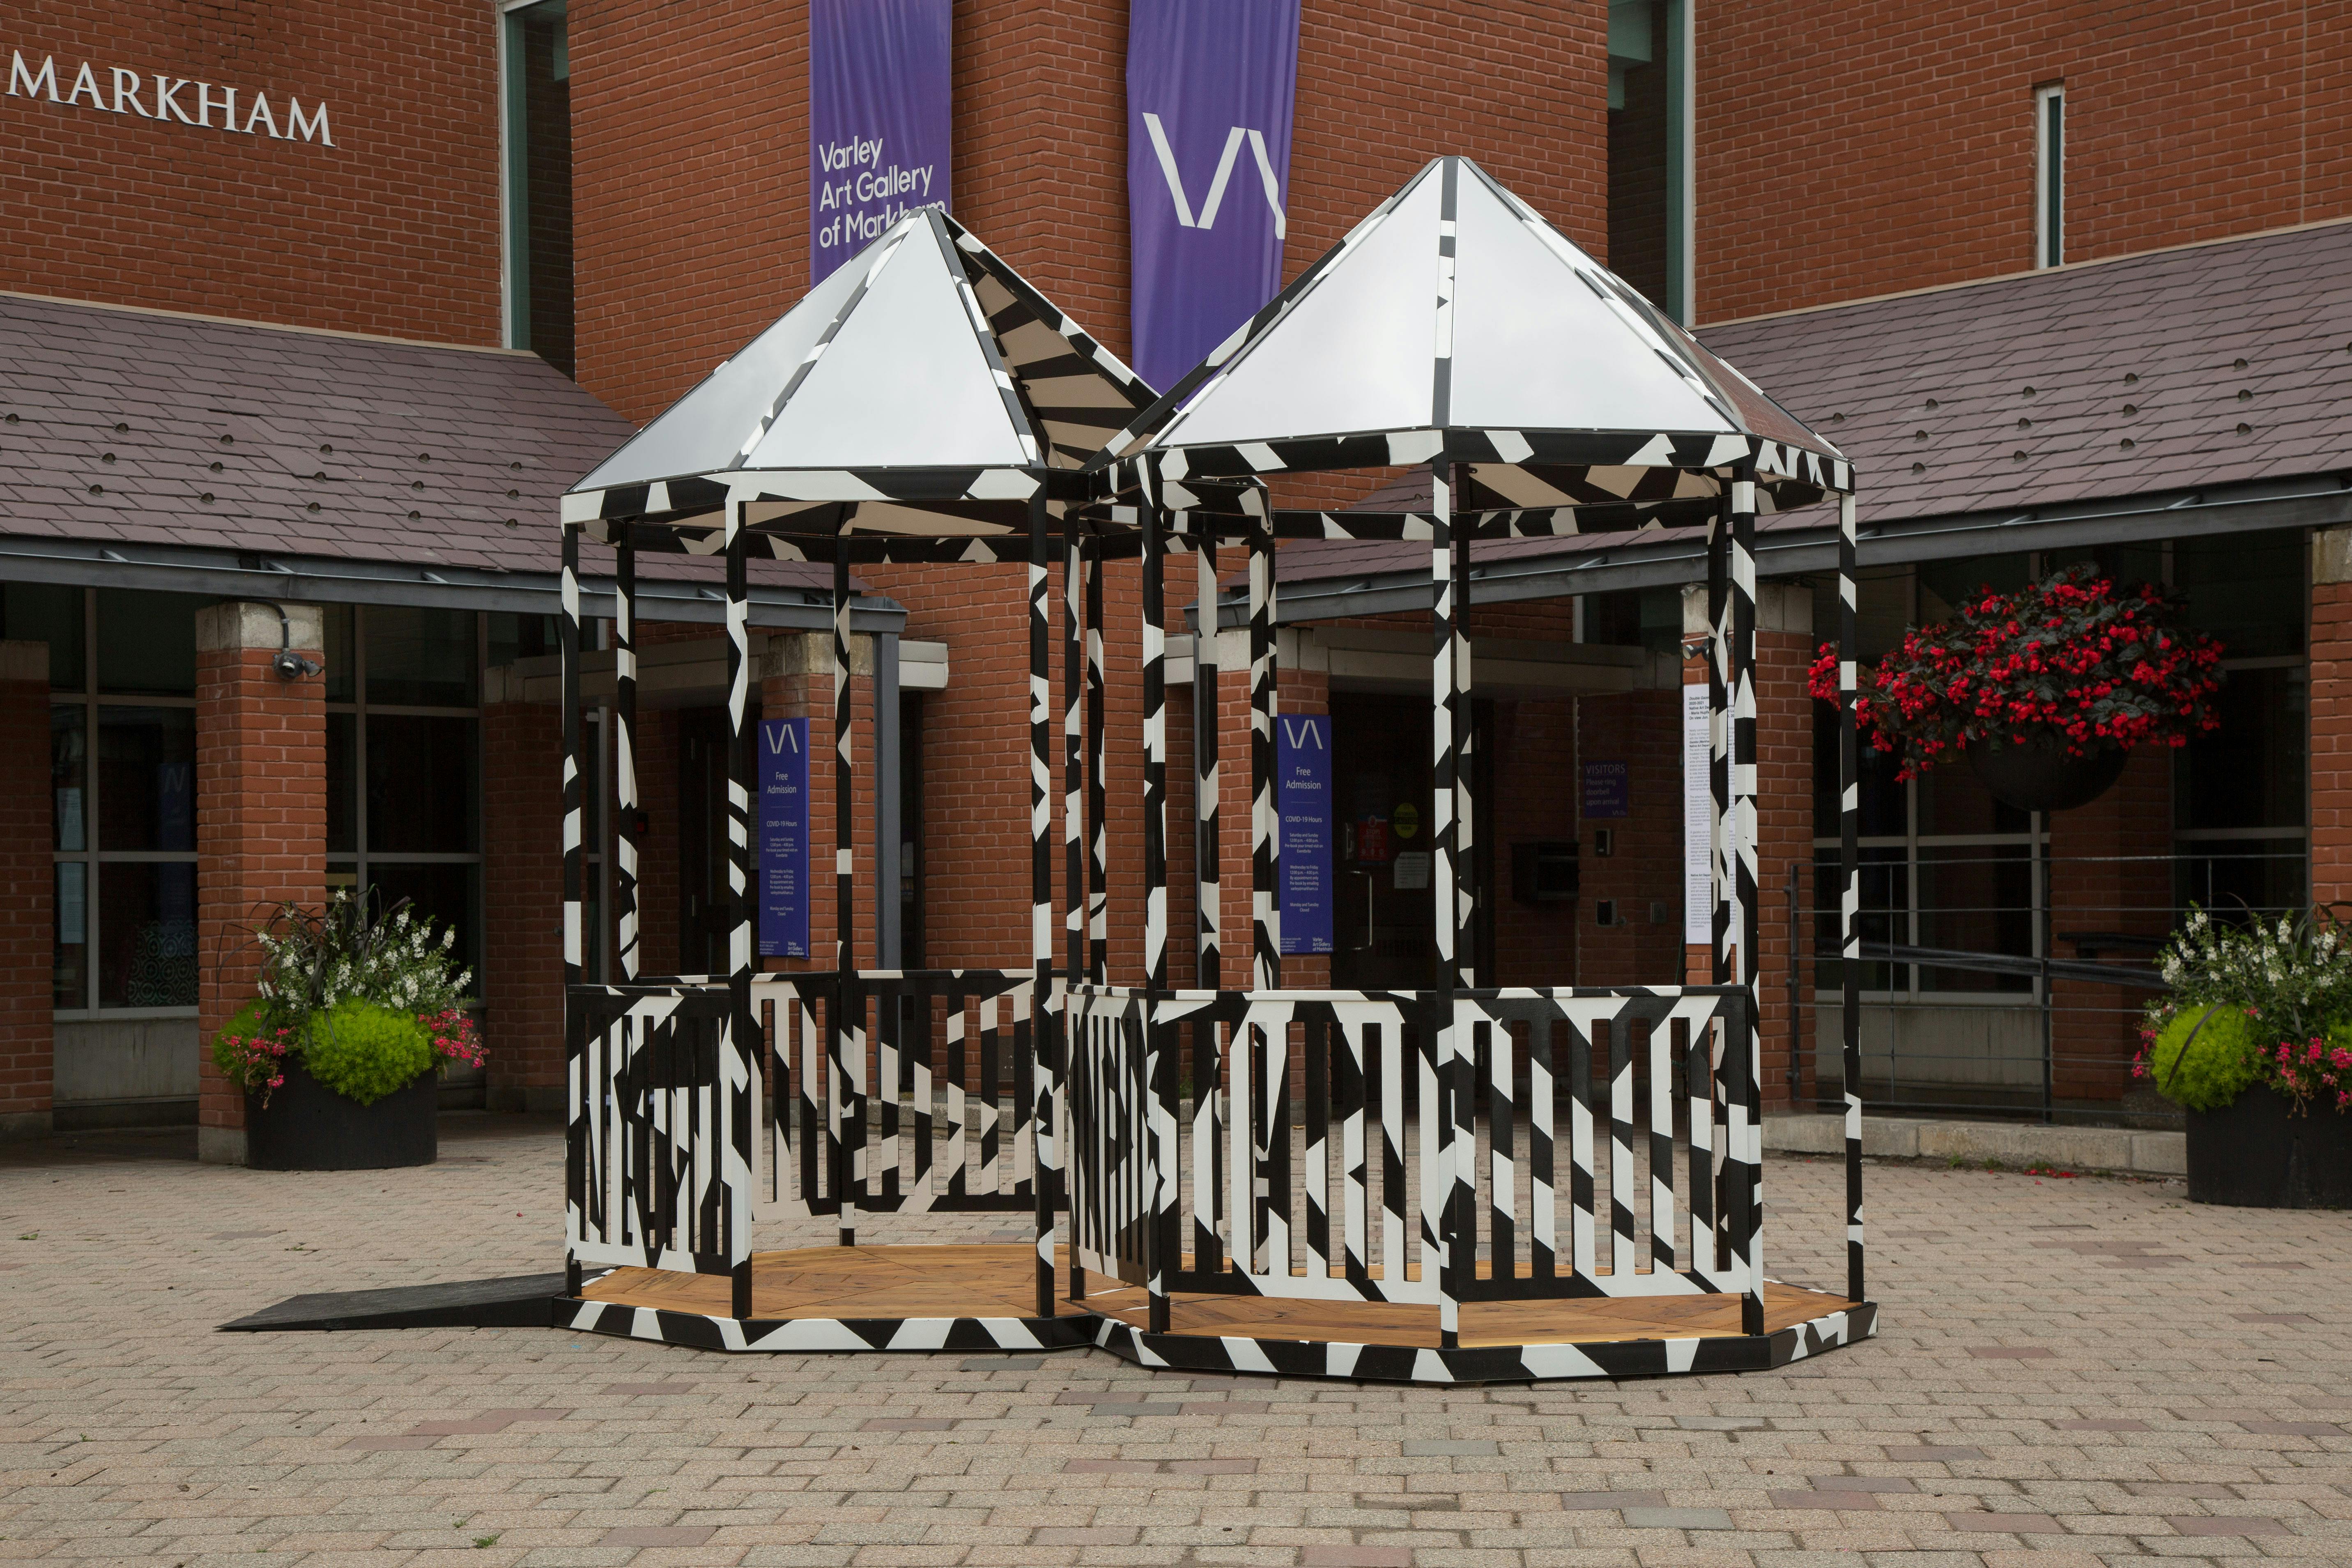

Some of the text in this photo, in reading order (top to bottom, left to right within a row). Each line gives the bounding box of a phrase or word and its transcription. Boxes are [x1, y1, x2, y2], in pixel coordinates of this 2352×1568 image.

[6, 49, 336, 147] MARKHAM
[819, 136, 883, 172] Varley
[819, 165, 933, 212] Art Gallery
[819, 216, 841, 248] of
[1296, 767, 1311, 775] Free
[1586, 764, 1625, 774] VISITORS
[776, 772, 788, 780] Free
[1286, 779, 1321, 789] Admission
[1605, 779, 1616, 787] ring
[767, 785, 797, 794] Admission
